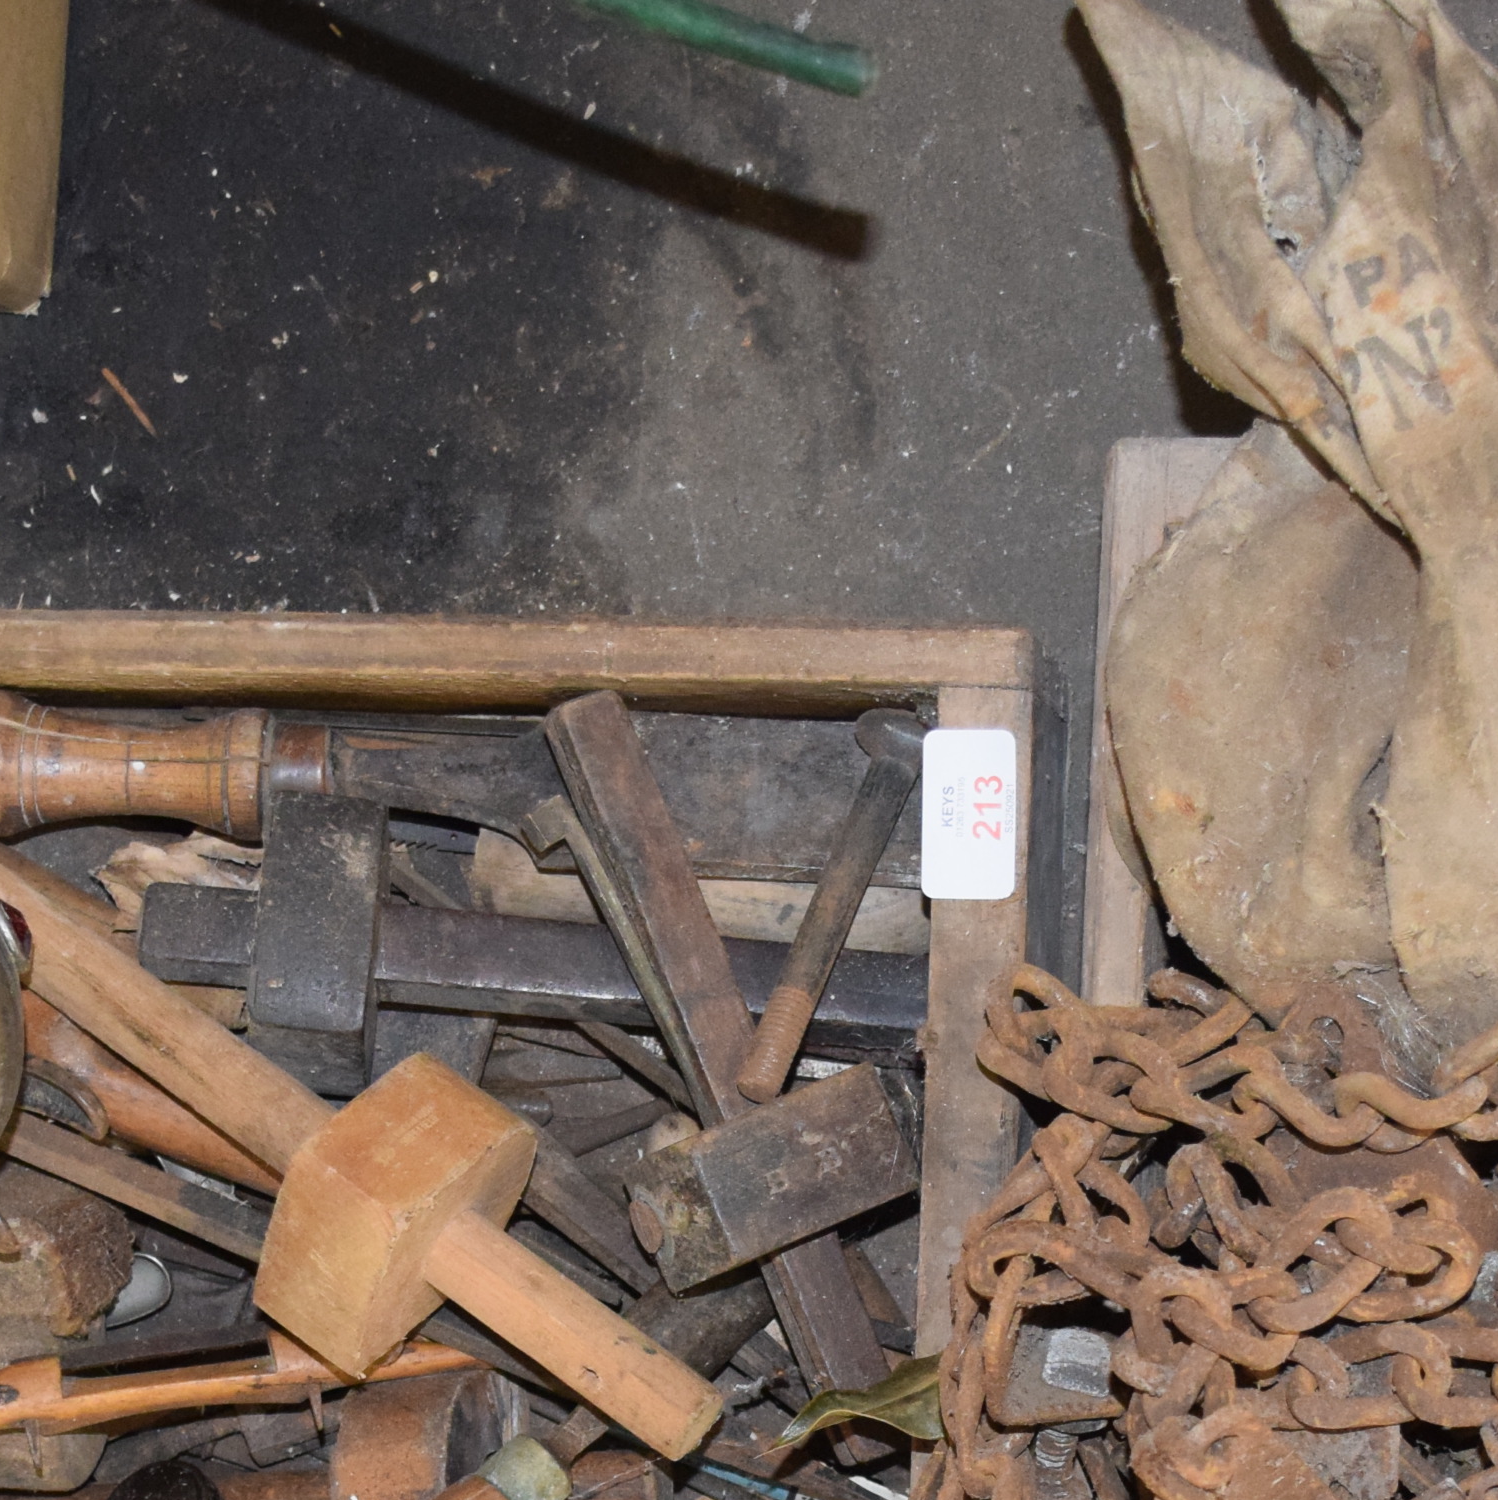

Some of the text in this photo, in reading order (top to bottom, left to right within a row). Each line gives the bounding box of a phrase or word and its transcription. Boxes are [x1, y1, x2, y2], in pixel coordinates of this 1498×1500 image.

[941, 785, 955, 827] KEYS
[971, 775, 1003, 840] 213
[1004, 783, 1014, 833] SS250921
